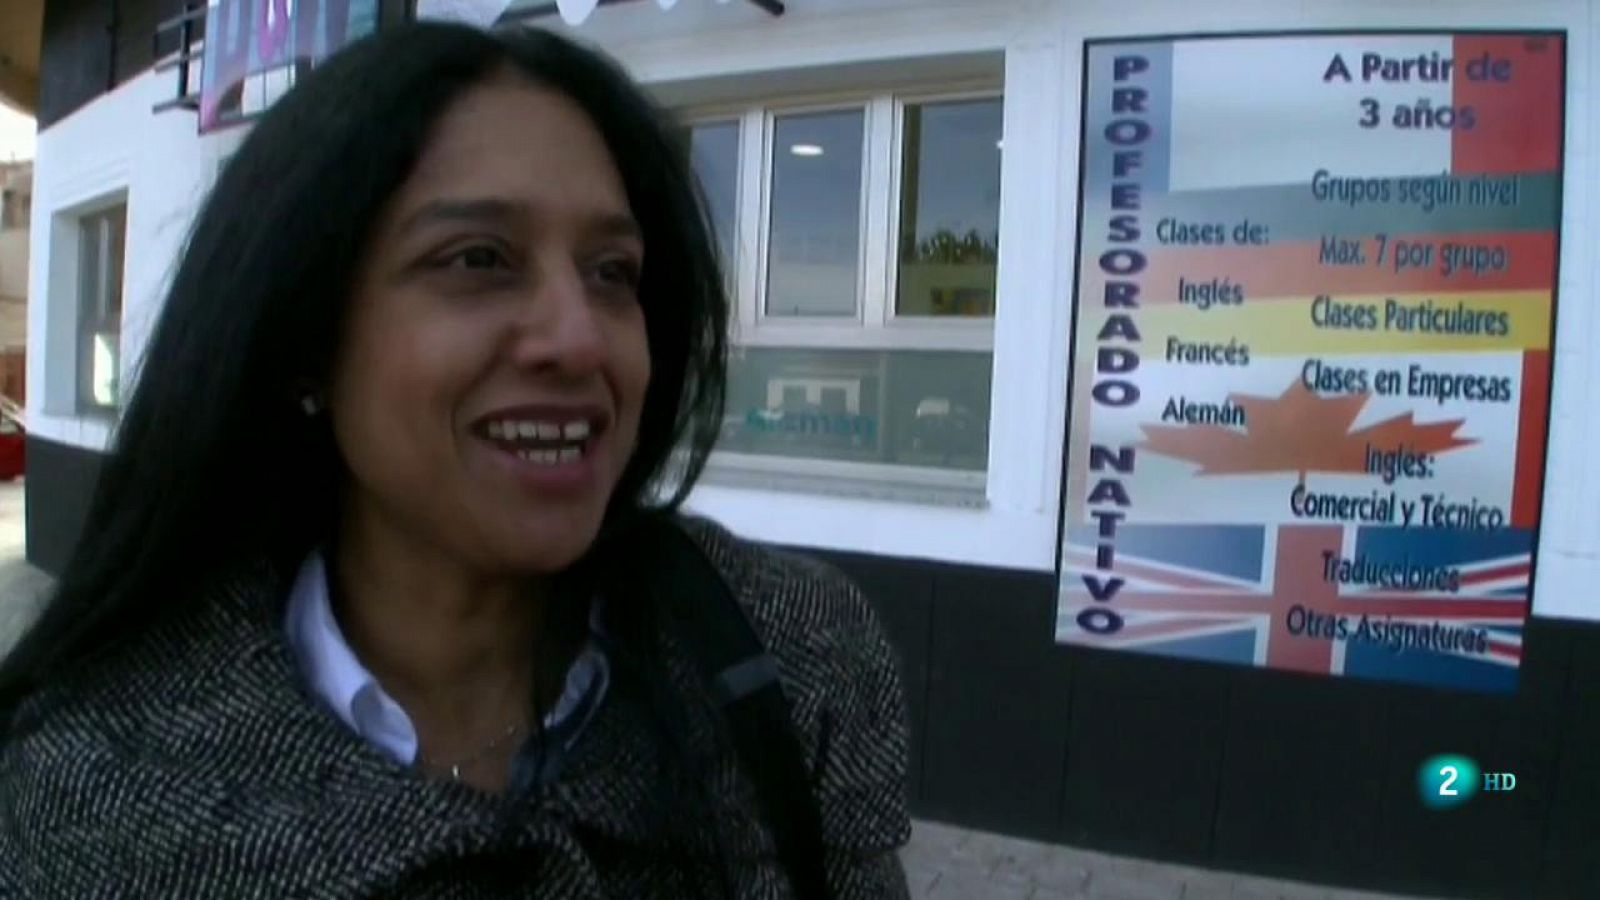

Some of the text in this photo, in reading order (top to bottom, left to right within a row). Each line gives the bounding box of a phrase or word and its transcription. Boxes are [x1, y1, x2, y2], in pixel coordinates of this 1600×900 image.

[1323, 52, 1513, 83] A Partir de
[1358, 97, 1477, 130] 3 años
[1311, 169, 1520, 208] Grupos según nivel
[1092, 55, 1152, 407] PROFESORADO
[1156, 217, 1270, 245] Clases de:
[1319, 235, 1507, 277] Max. 7 por grupo
[1178, 277, 1244, 310] Inglés
[1310, 295, 1510, 336] Clases Particulares
[1165, 337, 1250, 366] Francés
[1301, 359, 1512, 405] Clases en Empresas
[1161, 397, 1246, 427] Alemán
[1290, 488, 1504, 530] Comercial y Técnico
[1075, 445, 1137, 636] NATIVO
[1321, 550, 1460, 593] Traducciones
[1286, 605, 1488, 657] Otras Asignaturas
